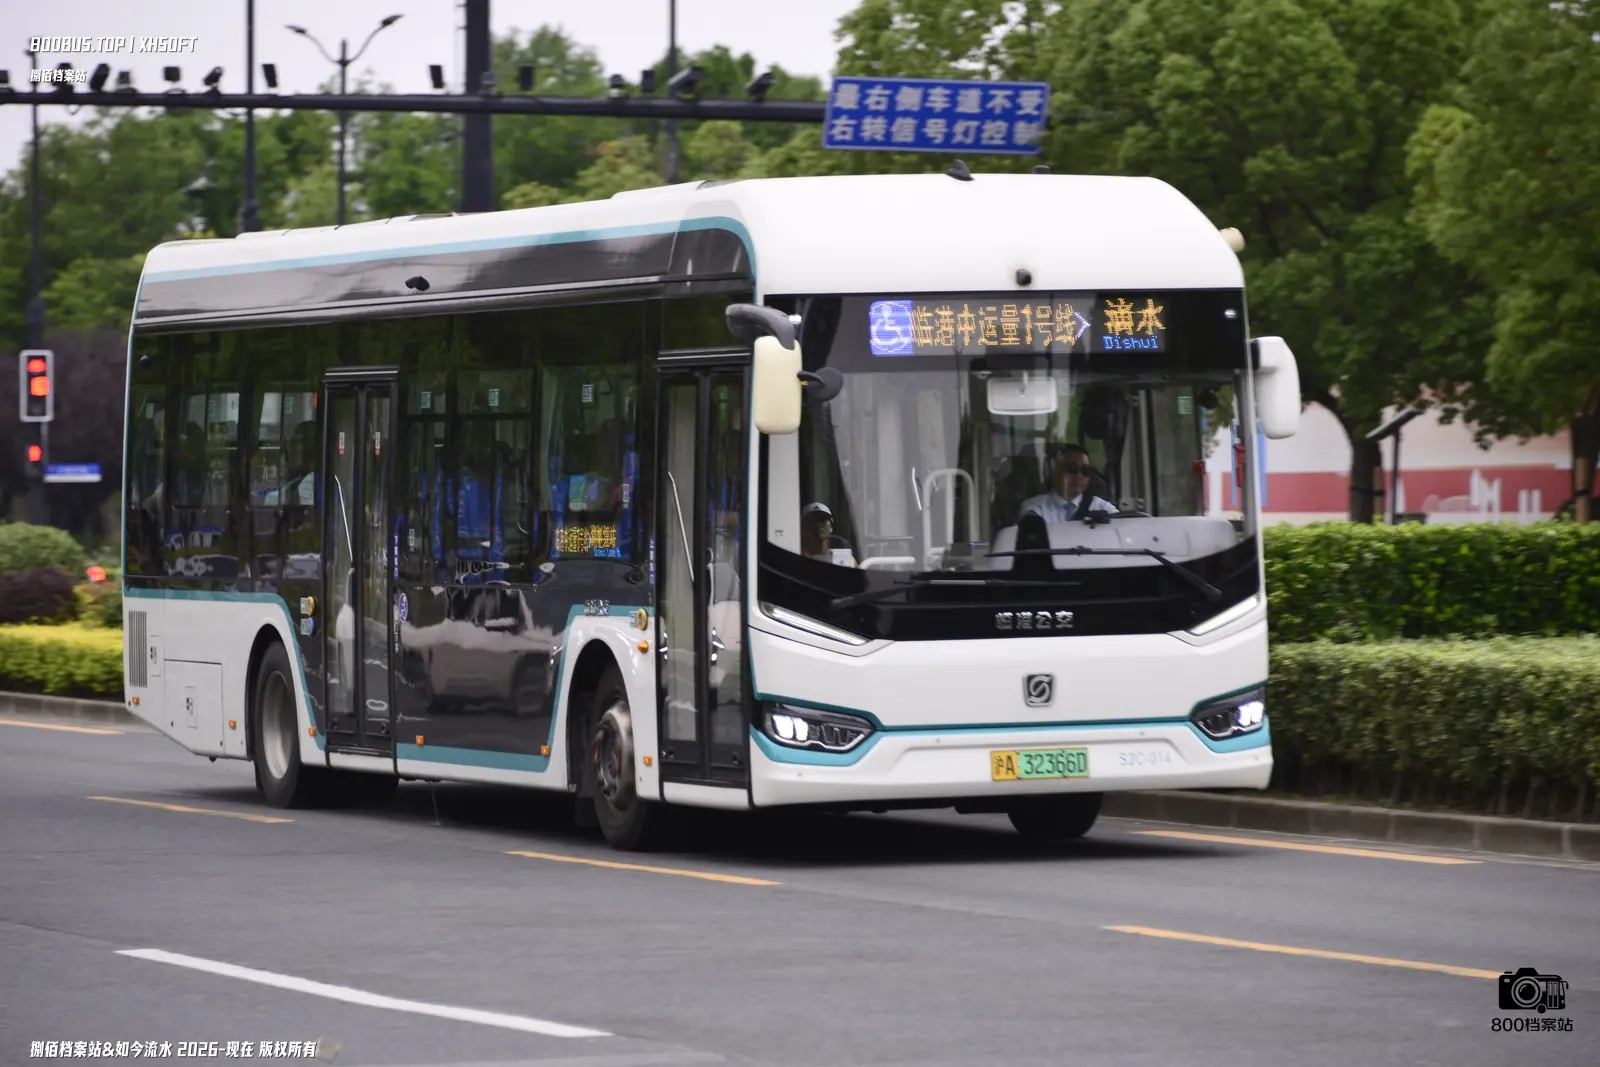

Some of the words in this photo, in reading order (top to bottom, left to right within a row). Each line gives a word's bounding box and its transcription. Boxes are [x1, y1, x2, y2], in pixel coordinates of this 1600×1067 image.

[834, 83, 1043, 115] 最右侧车道不受
[830, 115, 1041, 146] 右转信号灯控制
[912, 303, 1077, 346] 临港中运量1号线
[1104, 298, 1166, 335] 滴水
[1103, 335, 1158, 349] Dishui
